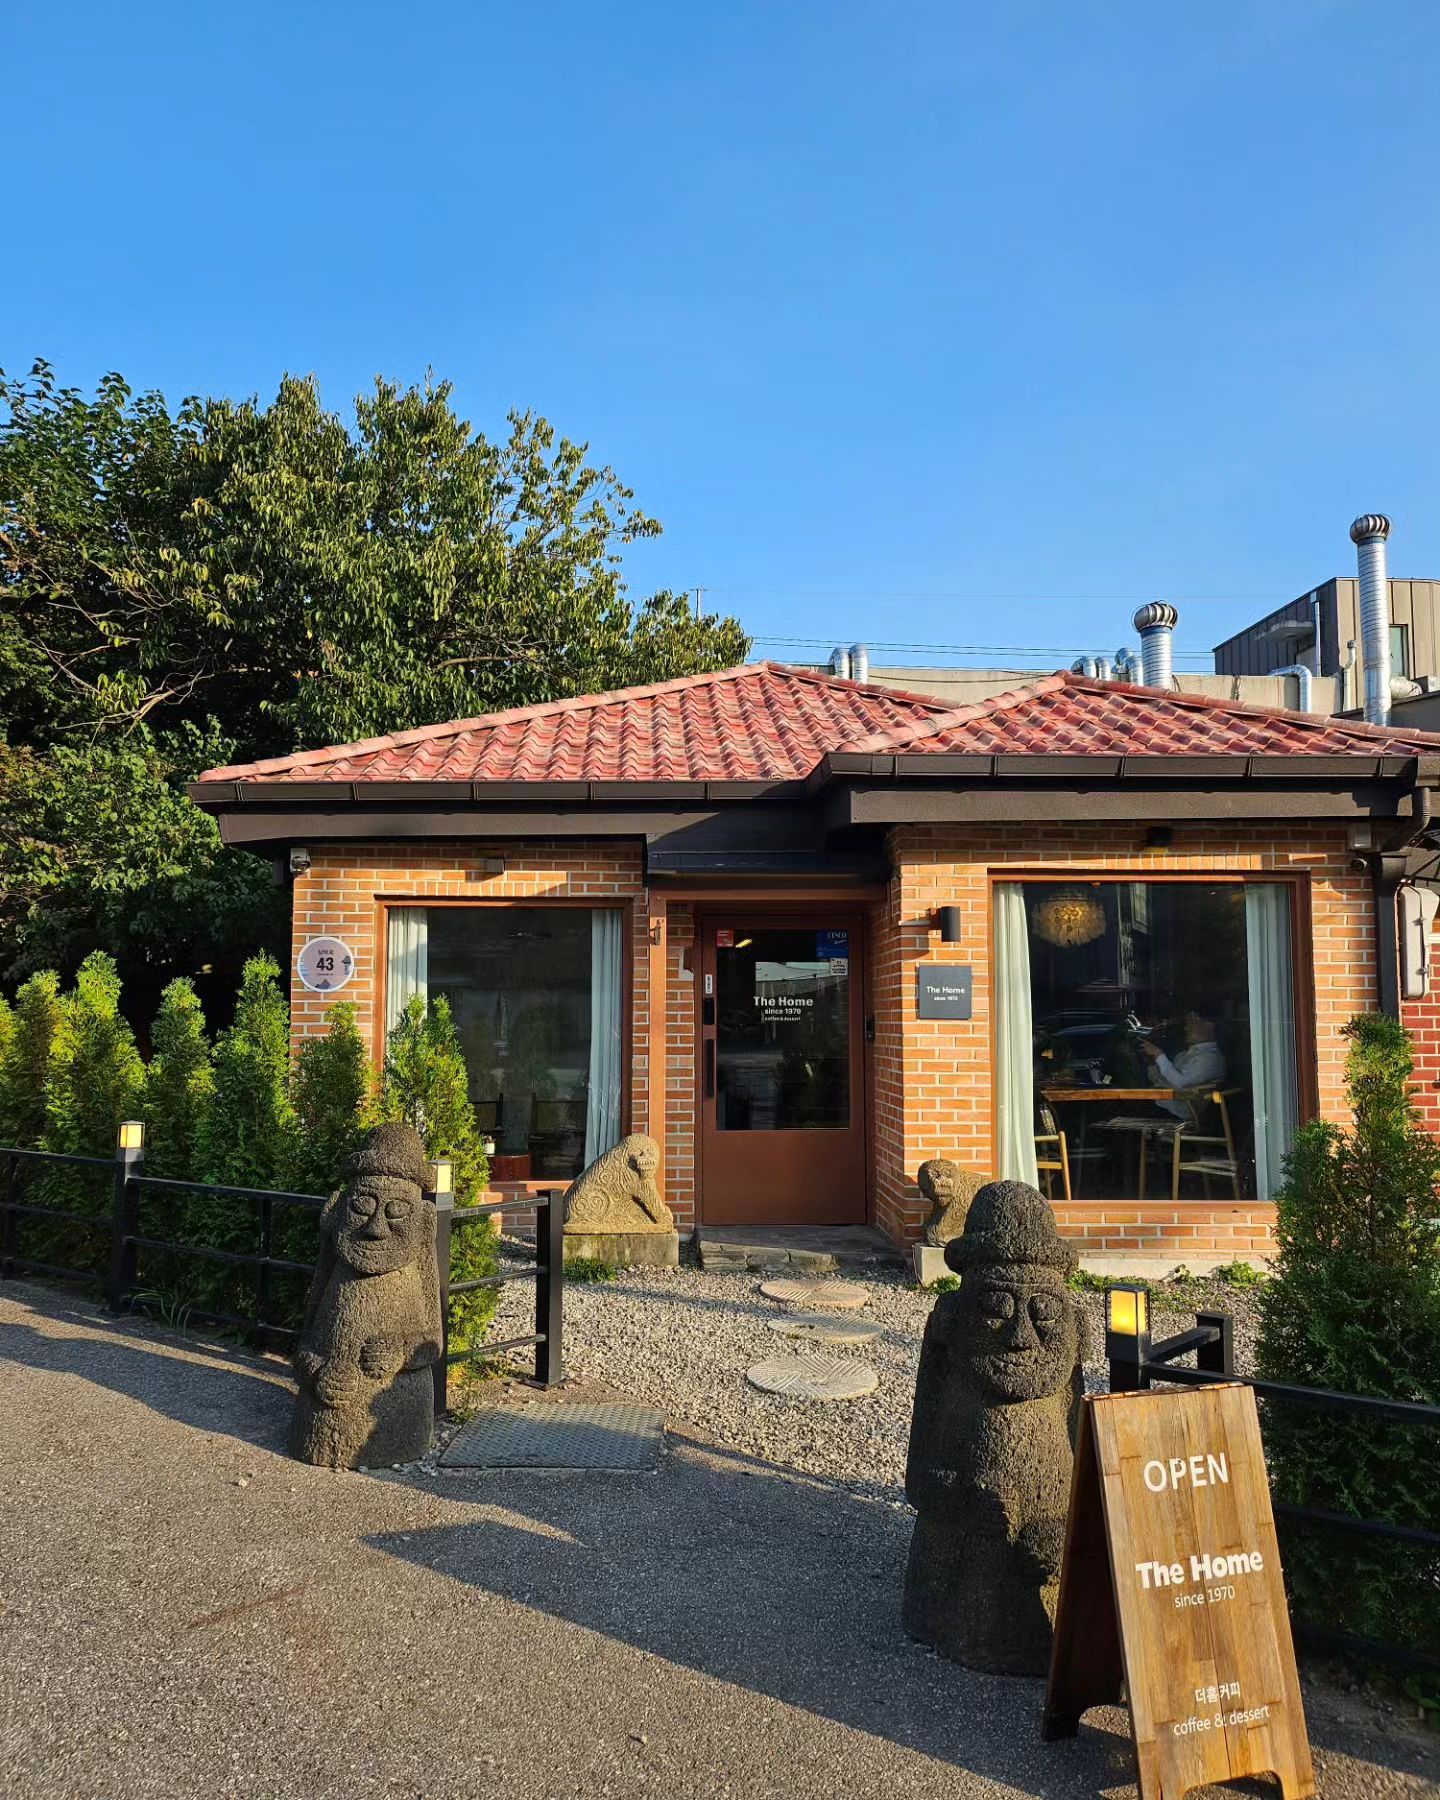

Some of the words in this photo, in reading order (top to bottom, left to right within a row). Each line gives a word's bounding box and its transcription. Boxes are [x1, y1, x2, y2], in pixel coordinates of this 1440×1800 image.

[316, 957, 334, 971] 43
[753, 996, 776, 1006] The
[778, 996, 814, 1006] Home
[1143, 1452, 1229, 1492] OPEN
[1135, 1561, 1185, 1590] The
[1190, 1551, 1264, 1582] Home
[1174, 1593, 1205, 1608] since
[1207, 1585, 1235, 1603] 1970
[1174, 1716, 1211, 1736] coffee
[1214, 1713, 1227, 1728] &
[1229, 1704, 1270, 1726] dessert
